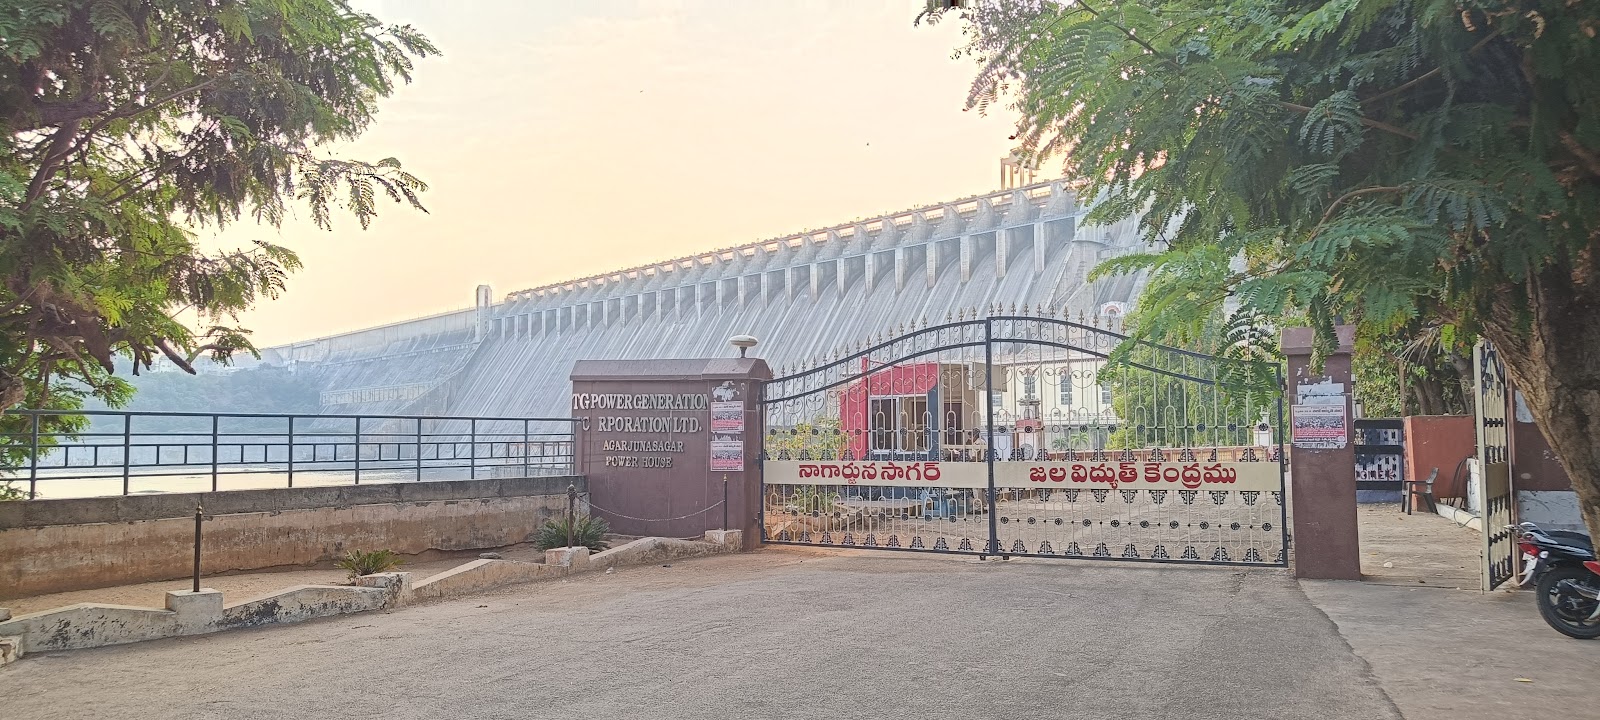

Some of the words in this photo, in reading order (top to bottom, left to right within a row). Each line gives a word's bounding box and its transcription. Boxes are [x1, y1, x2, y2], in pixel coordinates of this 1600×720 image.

[572, 393, 590, 410] TG
[590, 393, 633, 410] POWER
[634, 393, 709, 410] GENERATION
[673, 417, 702, 433] LTD.
[606, 456, 639, 468] POWER
[642, 457, 672, 469] HOUSE
